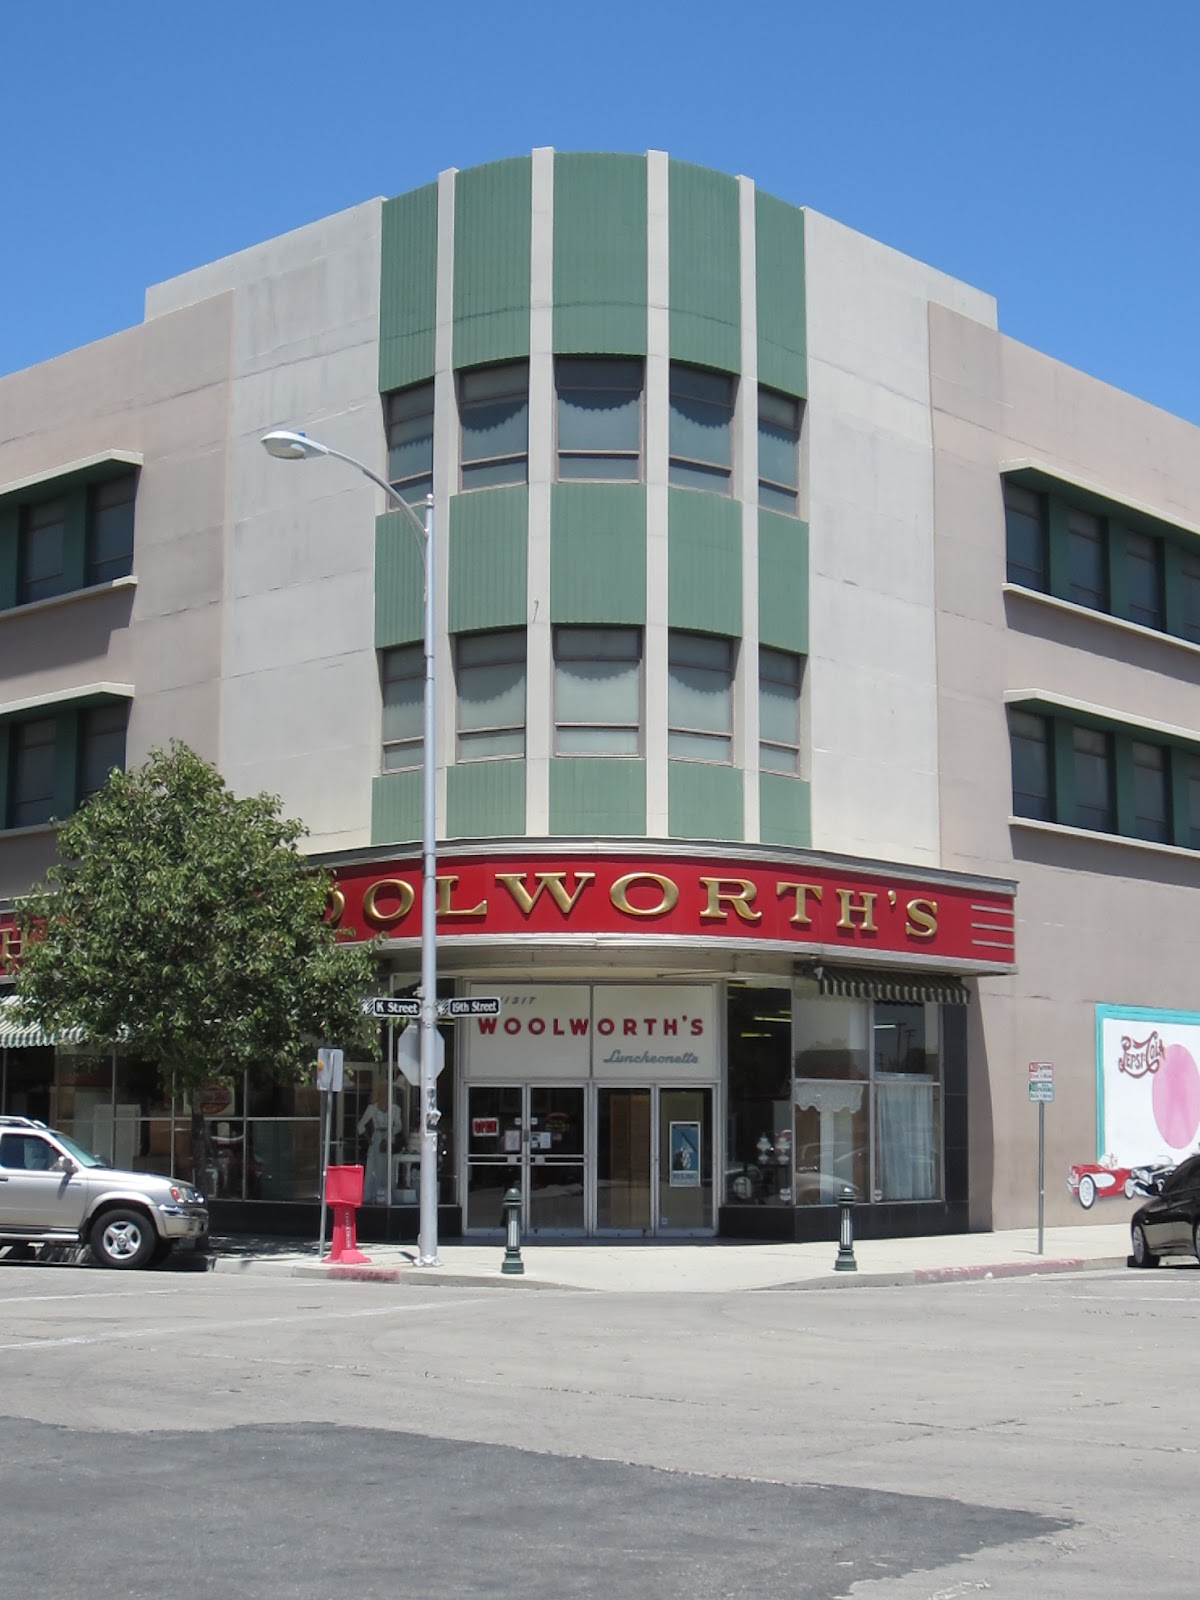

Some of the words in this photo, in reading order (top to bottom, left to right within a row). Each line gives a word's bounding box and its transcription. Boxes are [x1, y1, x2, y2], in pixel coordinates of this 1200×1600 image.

[325, 871, 938, 938] OLWORTH'S
[376, 1002, 384, 1012] K
[387, 1003, 418, 1014] Street
[452, 1001, 469, 1012] 19th
[471, 1000, 497, 1012] Street
[478, 1015, 704, 1035] WOOLWORTH'S
[603, 1049, 699, 1064] Luncheonette
